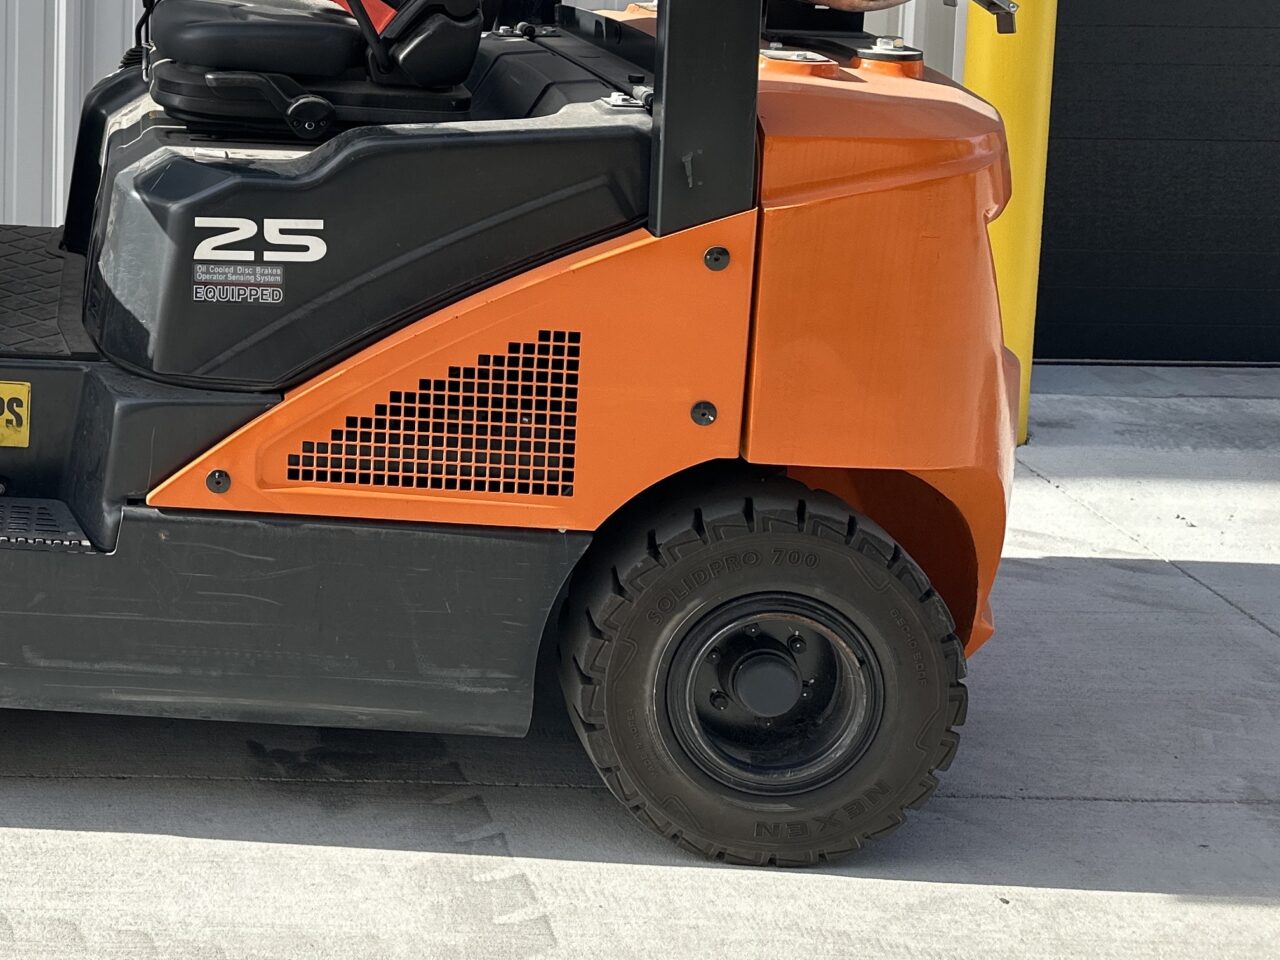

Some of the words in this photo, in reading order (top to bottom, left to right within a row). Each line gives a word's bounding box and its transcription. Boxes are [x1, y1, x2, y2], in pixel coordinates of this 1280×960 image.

[193, 216, 328, 262] 25
[196, 265, 207, 273] Oil
[209, 265, 234, 273] Cooled
[236, 266, 253, 274] Disc
[255, 266, 281, 275] Brakes
[196, 272, 227, 282] Operator
[227, 273, 255, 283] Sensing
[255, 274, 281, 283] System
[193, 284, 283, 303] EQUIPPED
[647, 551, 761, 626] SOLIDPRO
[771, 548, 819, 569] 700
[753, 778, 895, 839] NEXEN
